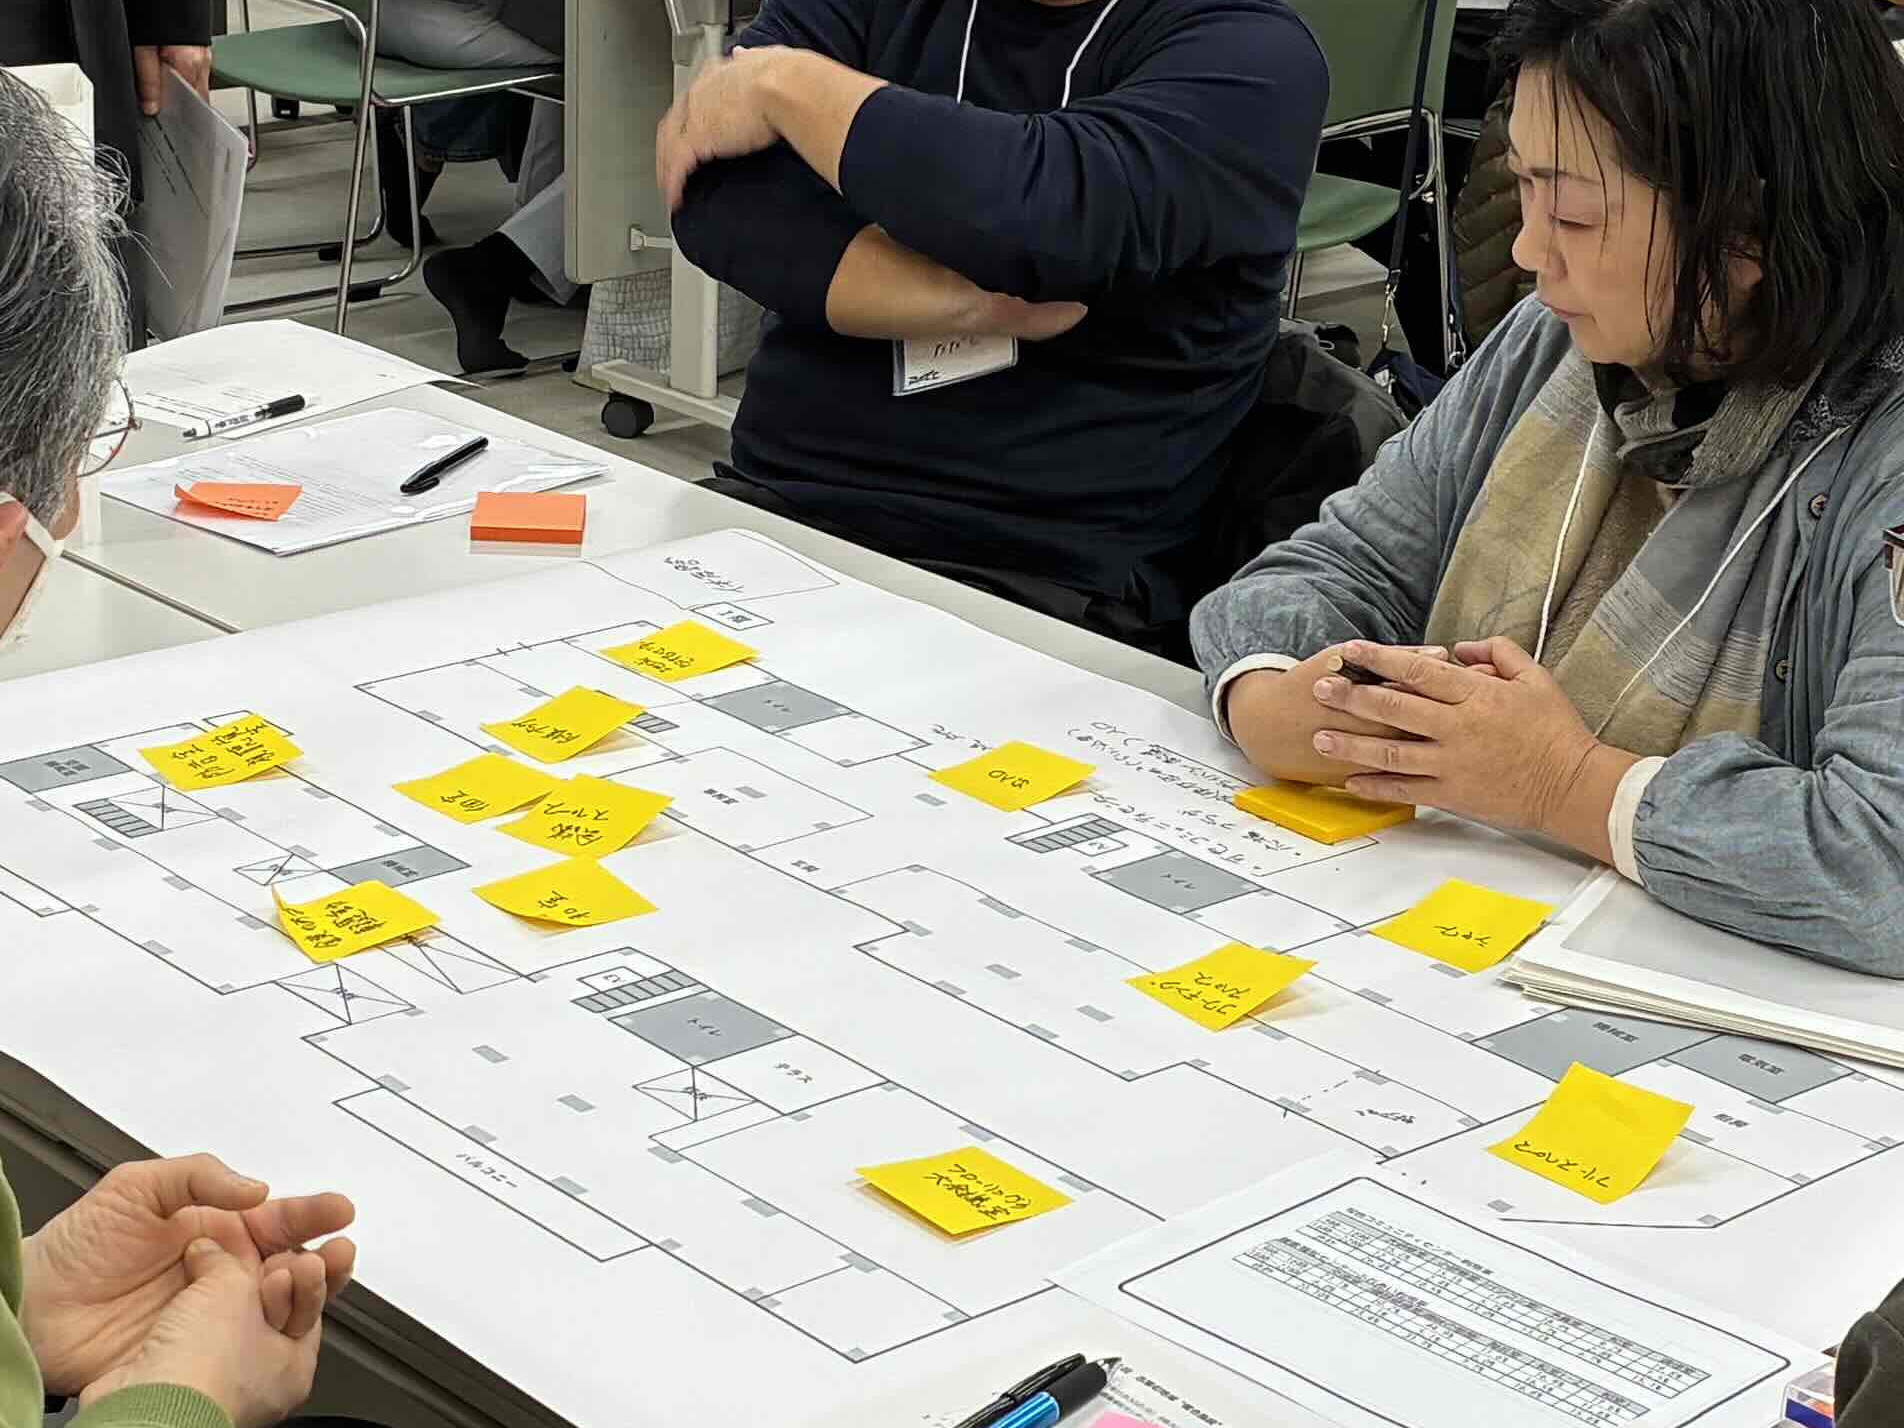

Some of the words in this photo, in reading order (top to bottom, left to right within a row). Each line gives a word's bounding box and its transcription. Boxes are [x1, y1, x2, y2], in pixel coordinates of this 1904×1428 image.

[685, 1015, 724, 1039] トイレ
[454, 1150, 521, 1191] バルコニー
